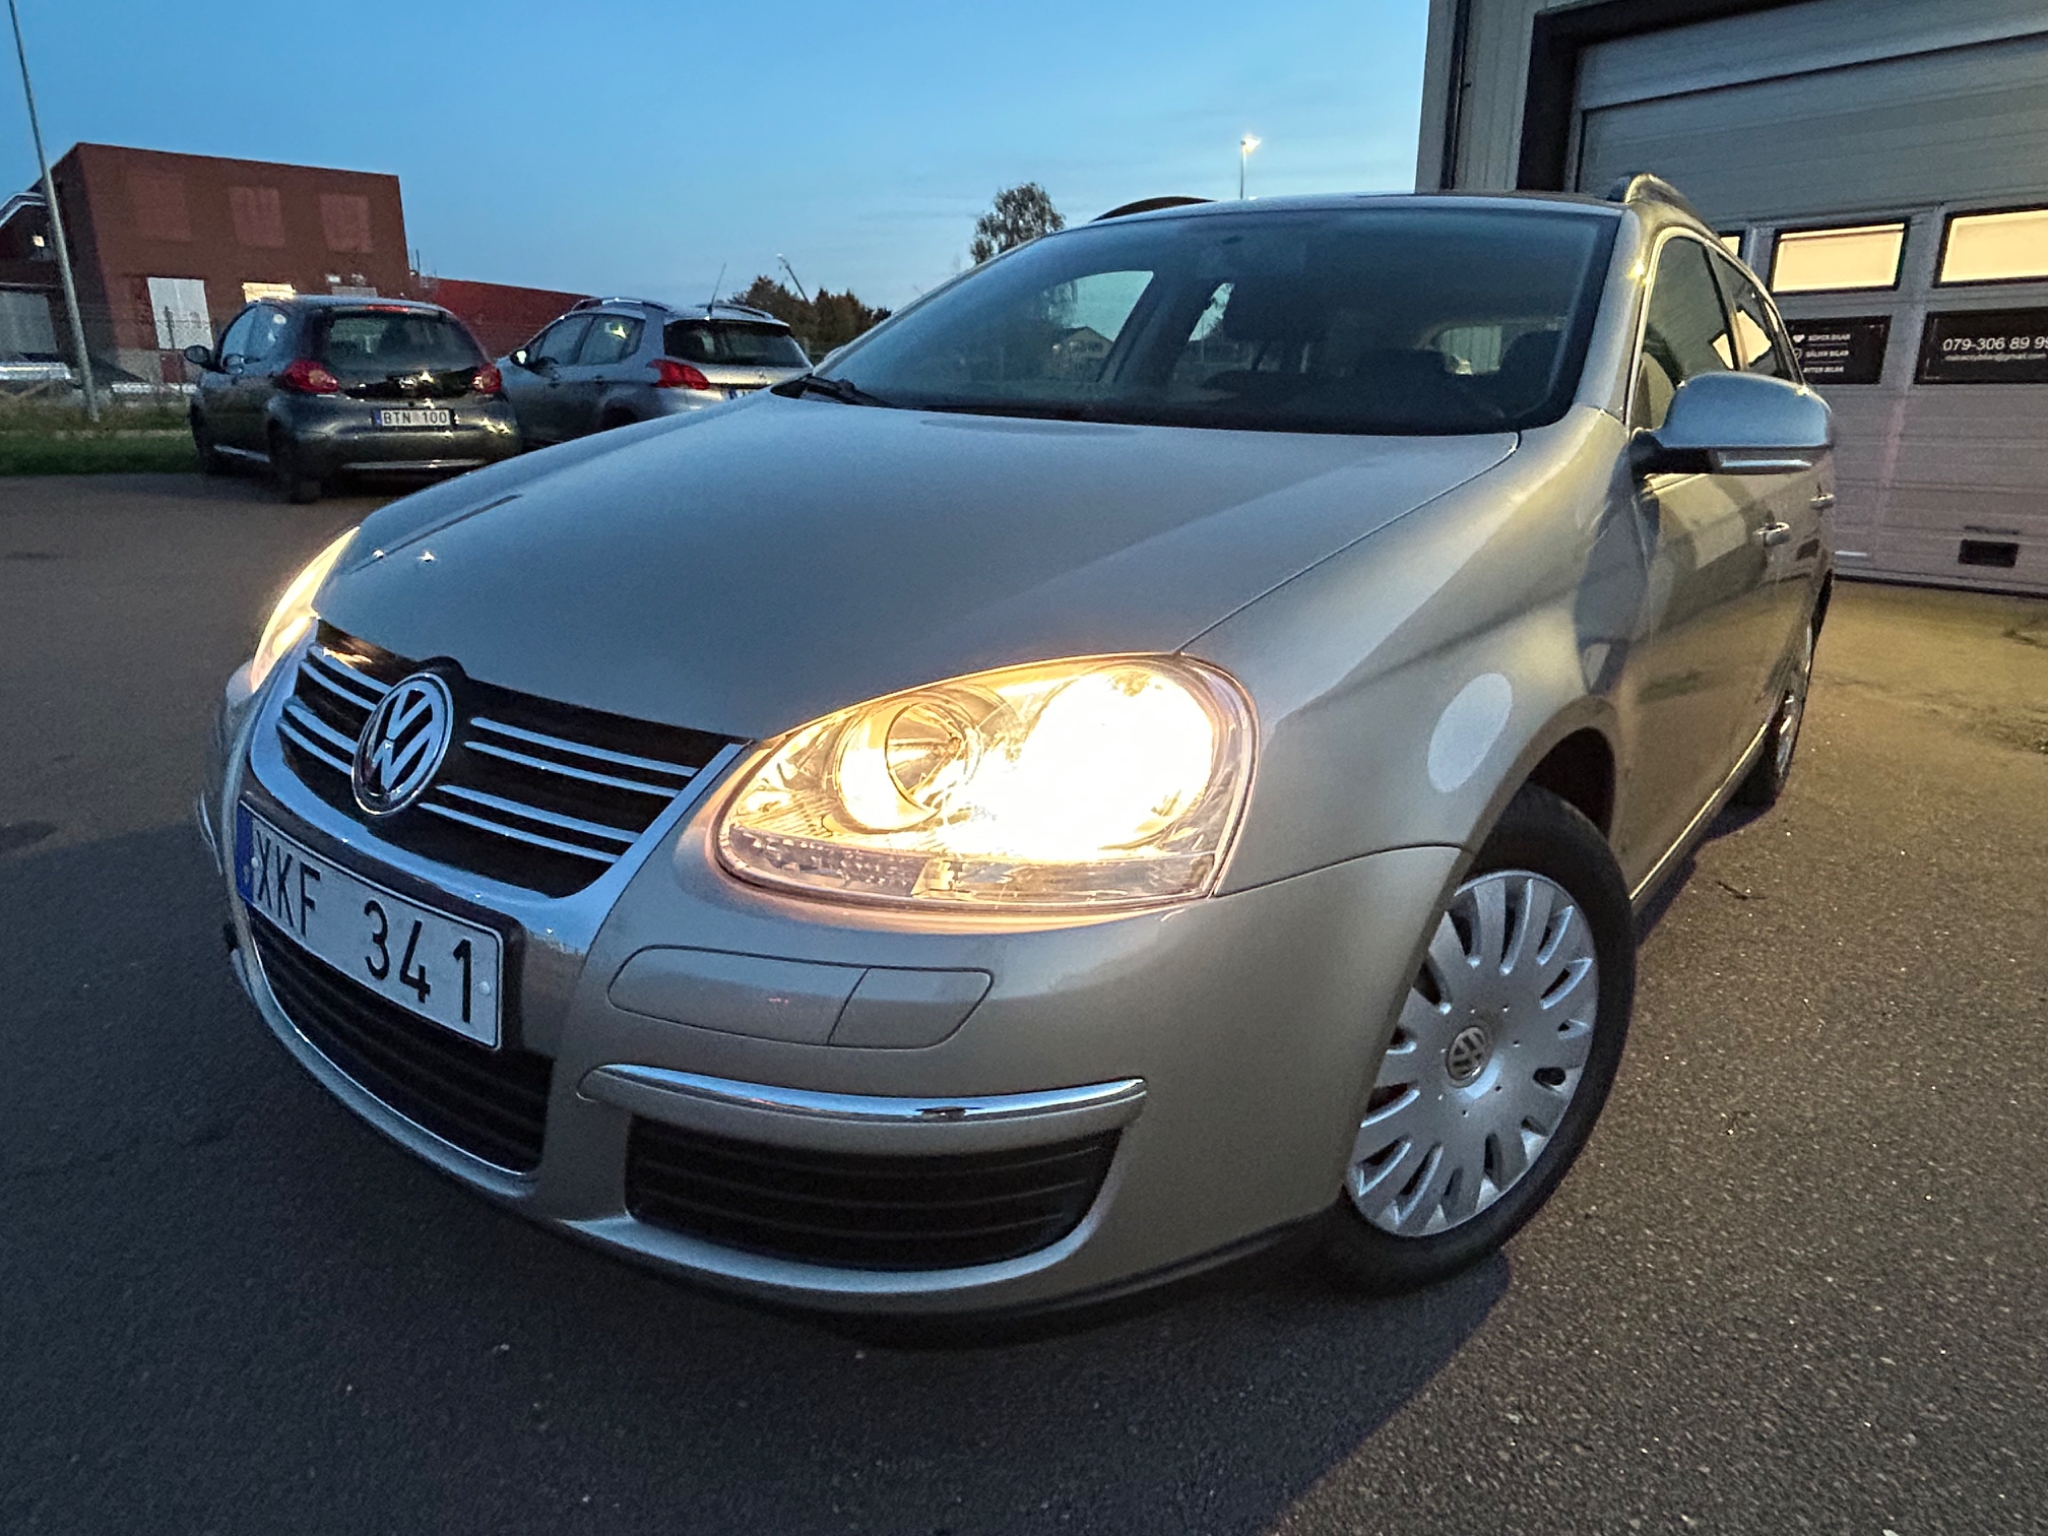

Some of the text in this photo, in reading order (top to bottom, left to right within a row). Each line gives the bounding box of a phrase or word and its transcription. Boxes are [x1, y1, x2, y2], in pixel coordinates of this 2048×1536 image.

[1943, 338, 2005, 351] 079-306
[2009, 337, 2030, 350] 89
[383, 411, 447, 424] BTN 100
[256, 830, 471, 1024] XKF 341
